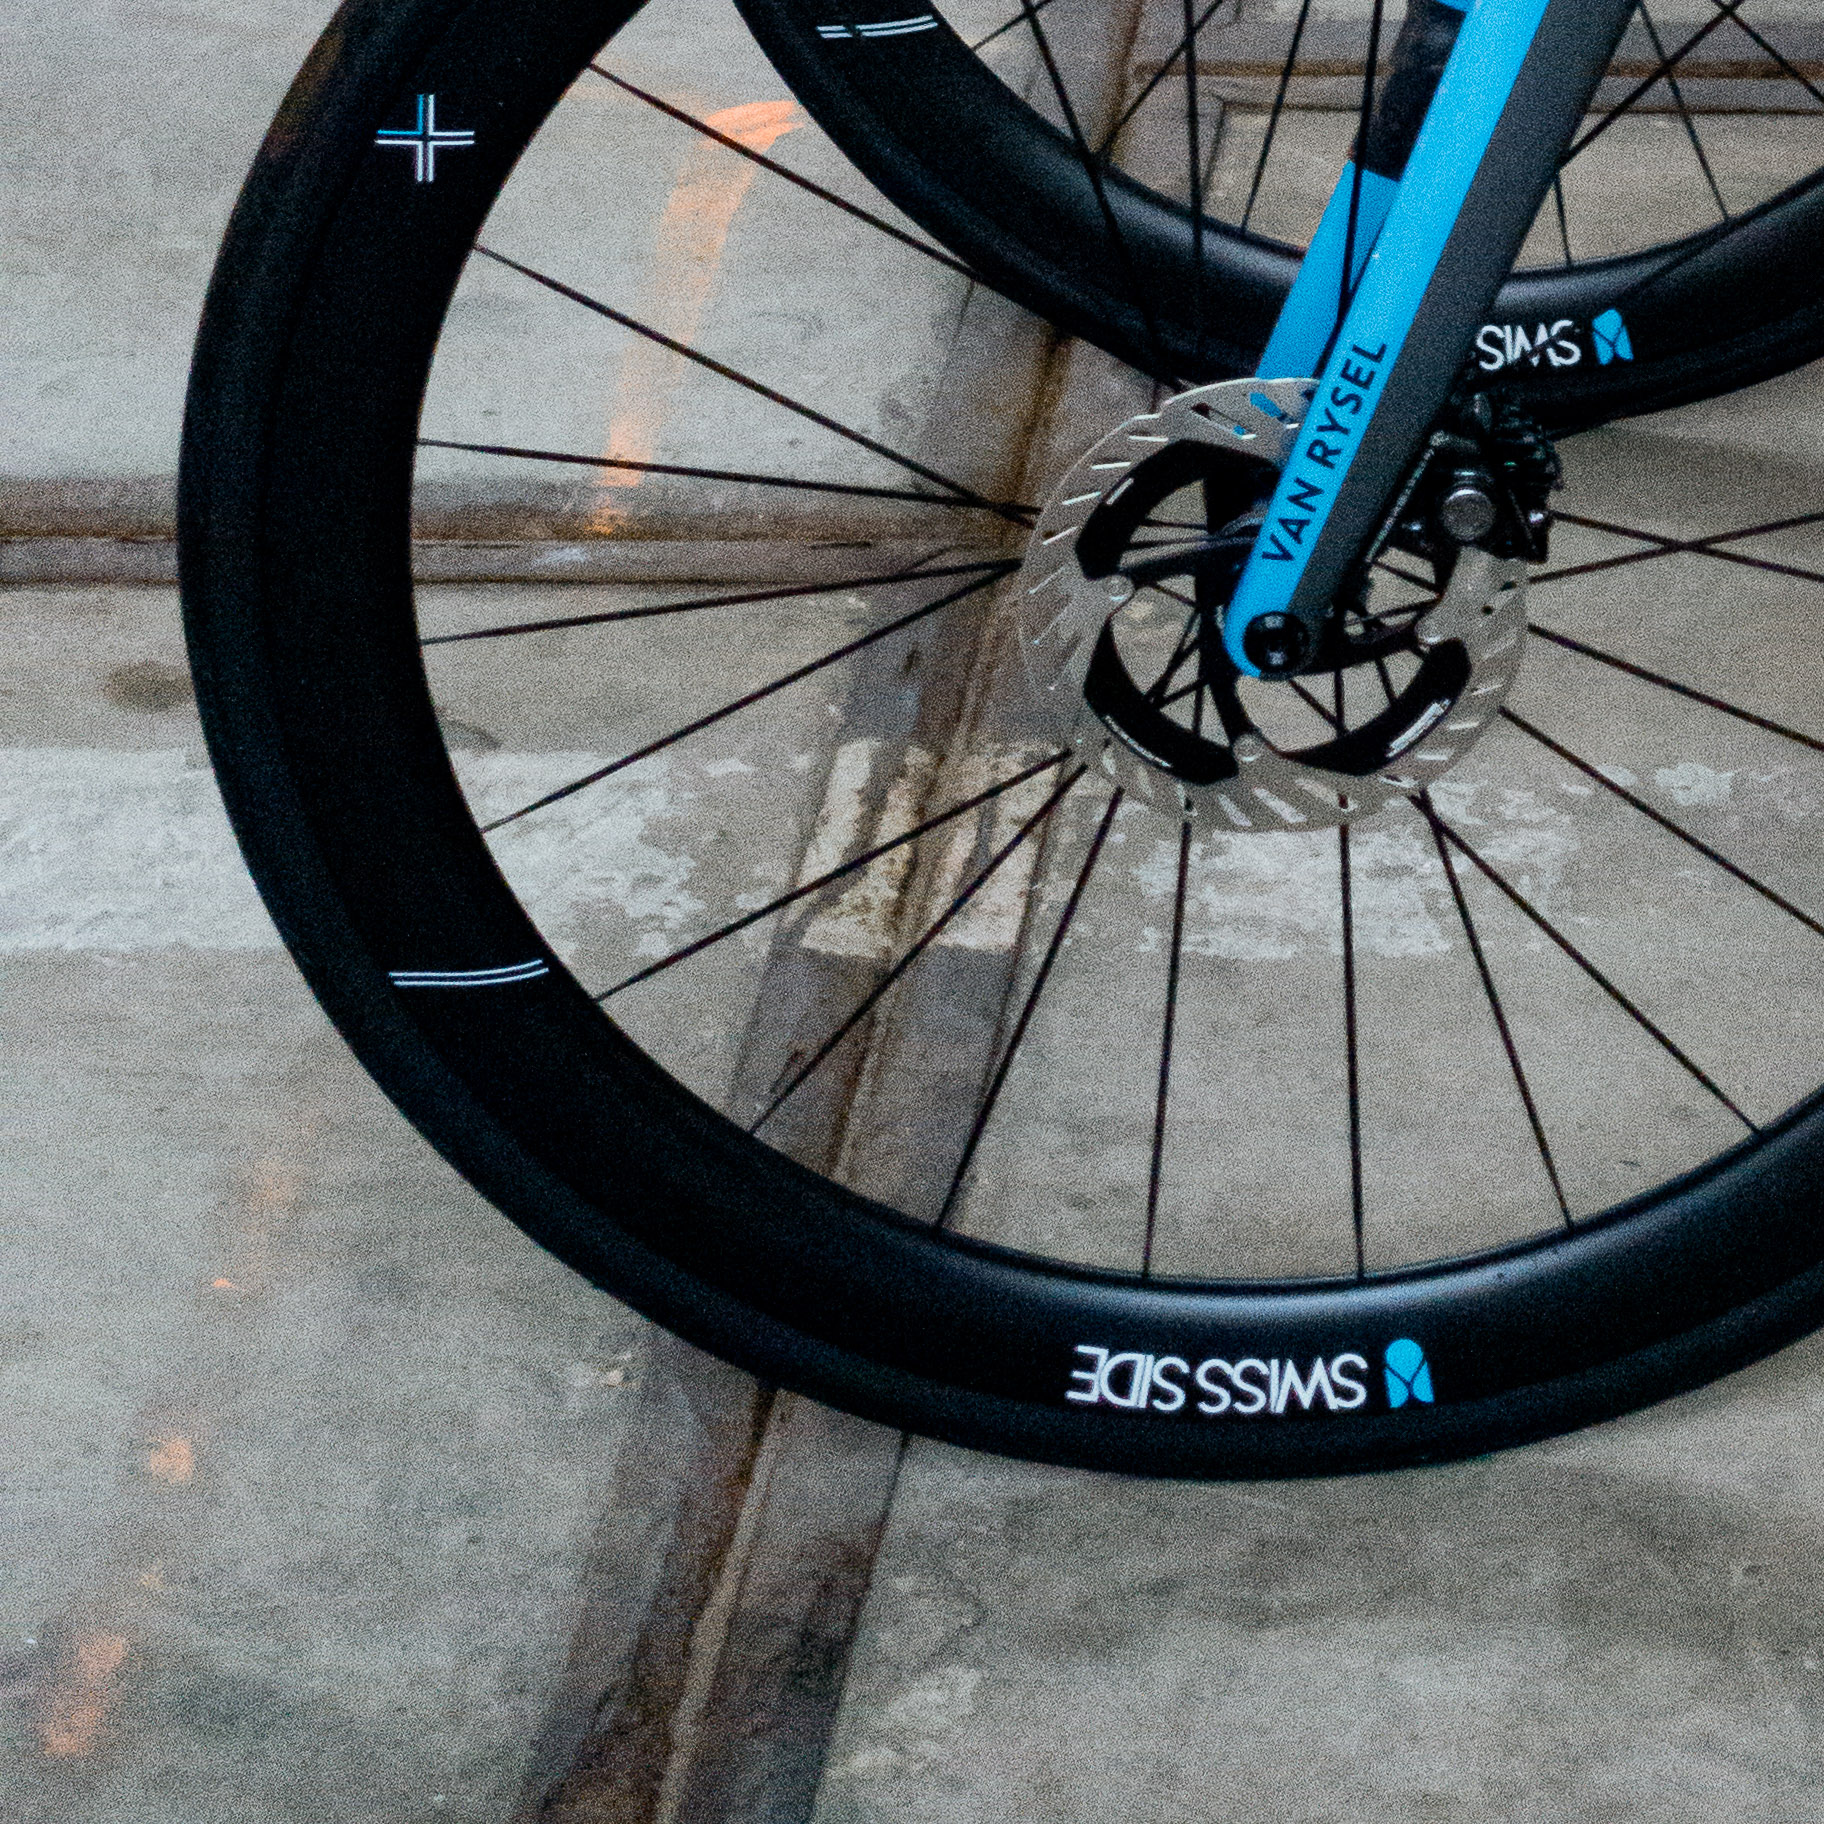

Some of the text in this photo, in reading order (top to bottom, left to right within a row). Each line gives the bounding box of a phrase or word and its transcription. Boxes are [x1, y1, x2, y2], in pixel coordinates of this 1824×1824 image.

[1476, 319, 1581, 370] SWIS
[1261, 342, 1387, 562] VAN RYSEL
[1066, 1344, 1369, 1414] SWISS SIDE
